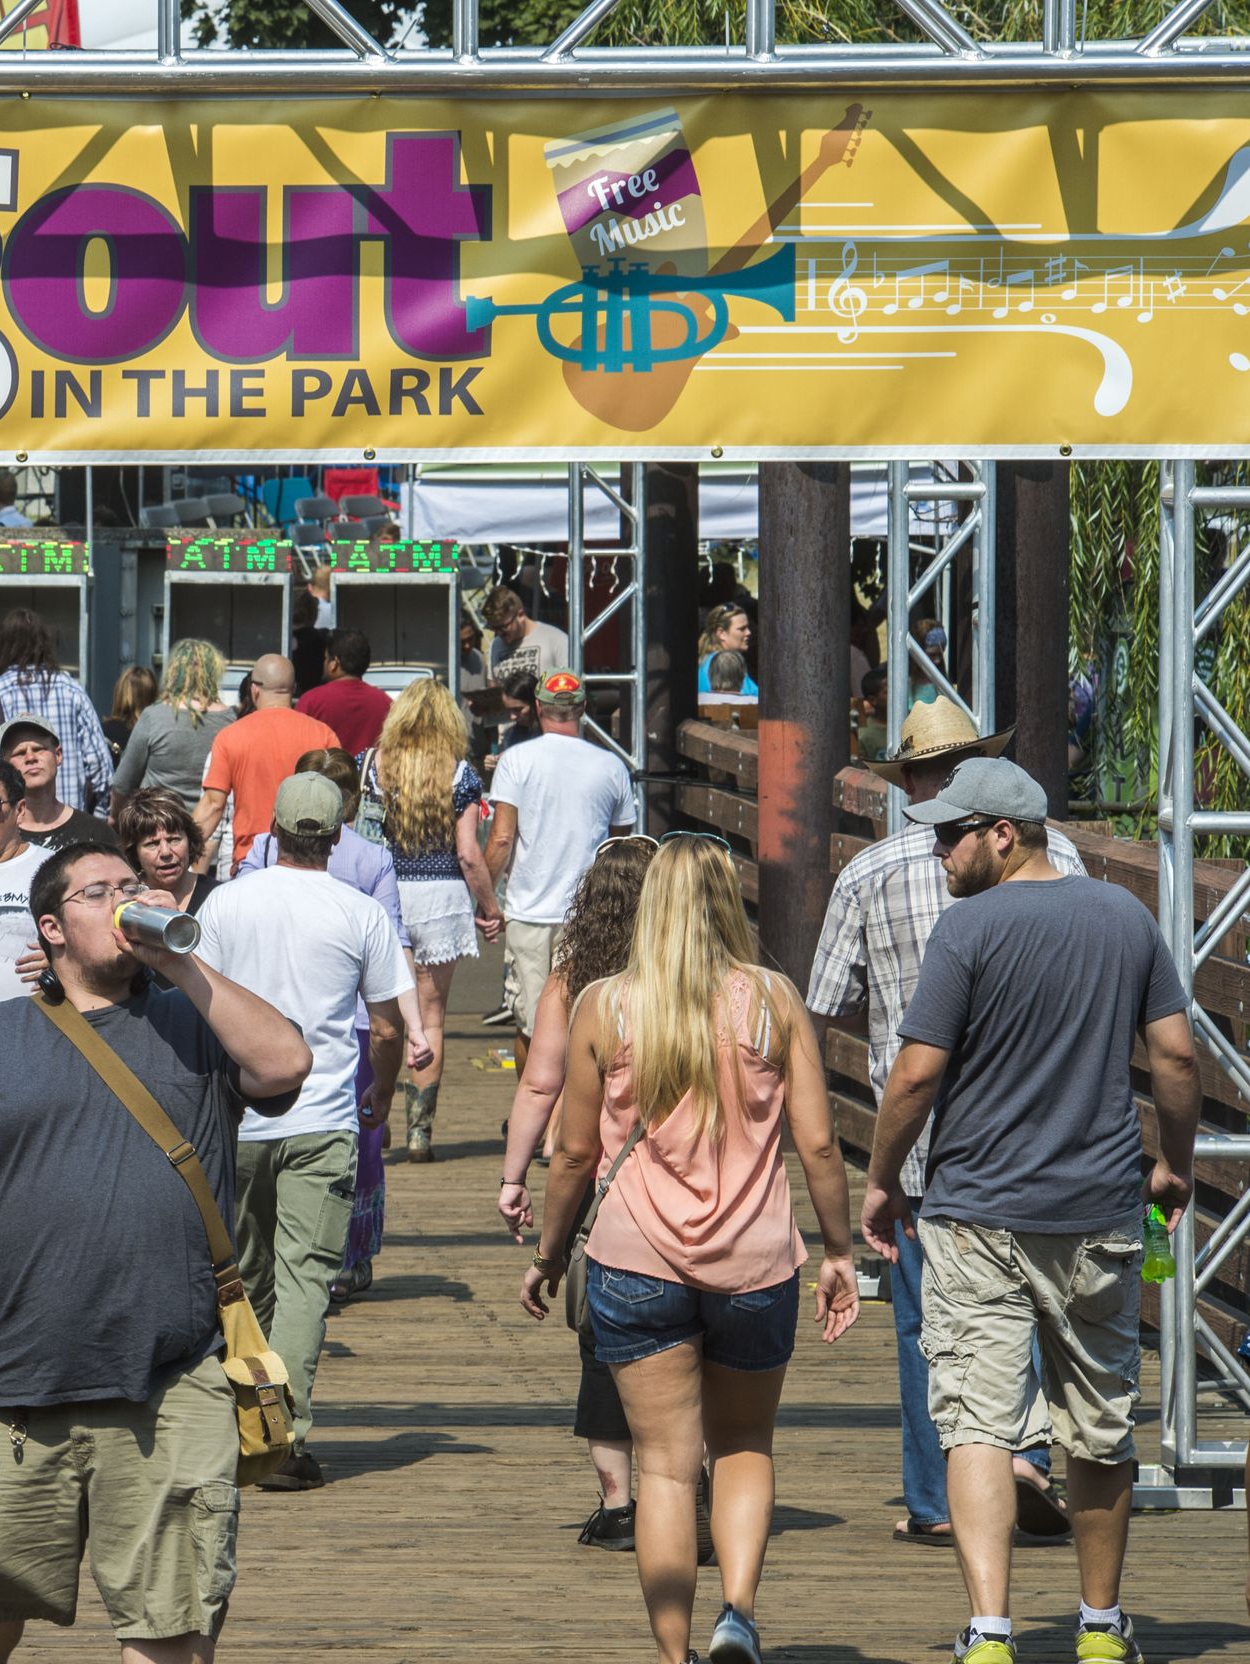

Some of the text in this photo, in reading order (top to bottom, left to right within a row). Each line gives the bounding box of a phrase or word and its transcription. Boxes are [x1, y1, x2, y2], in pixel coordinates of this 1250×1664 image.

[587, 168, 660, 211] Free
[590, 201, 686, 257] Music
[30, 366, 486, 419] IN THE PARK
[180, 544, 276, 571] ATM
[347, 543, 442, 569] ATM
